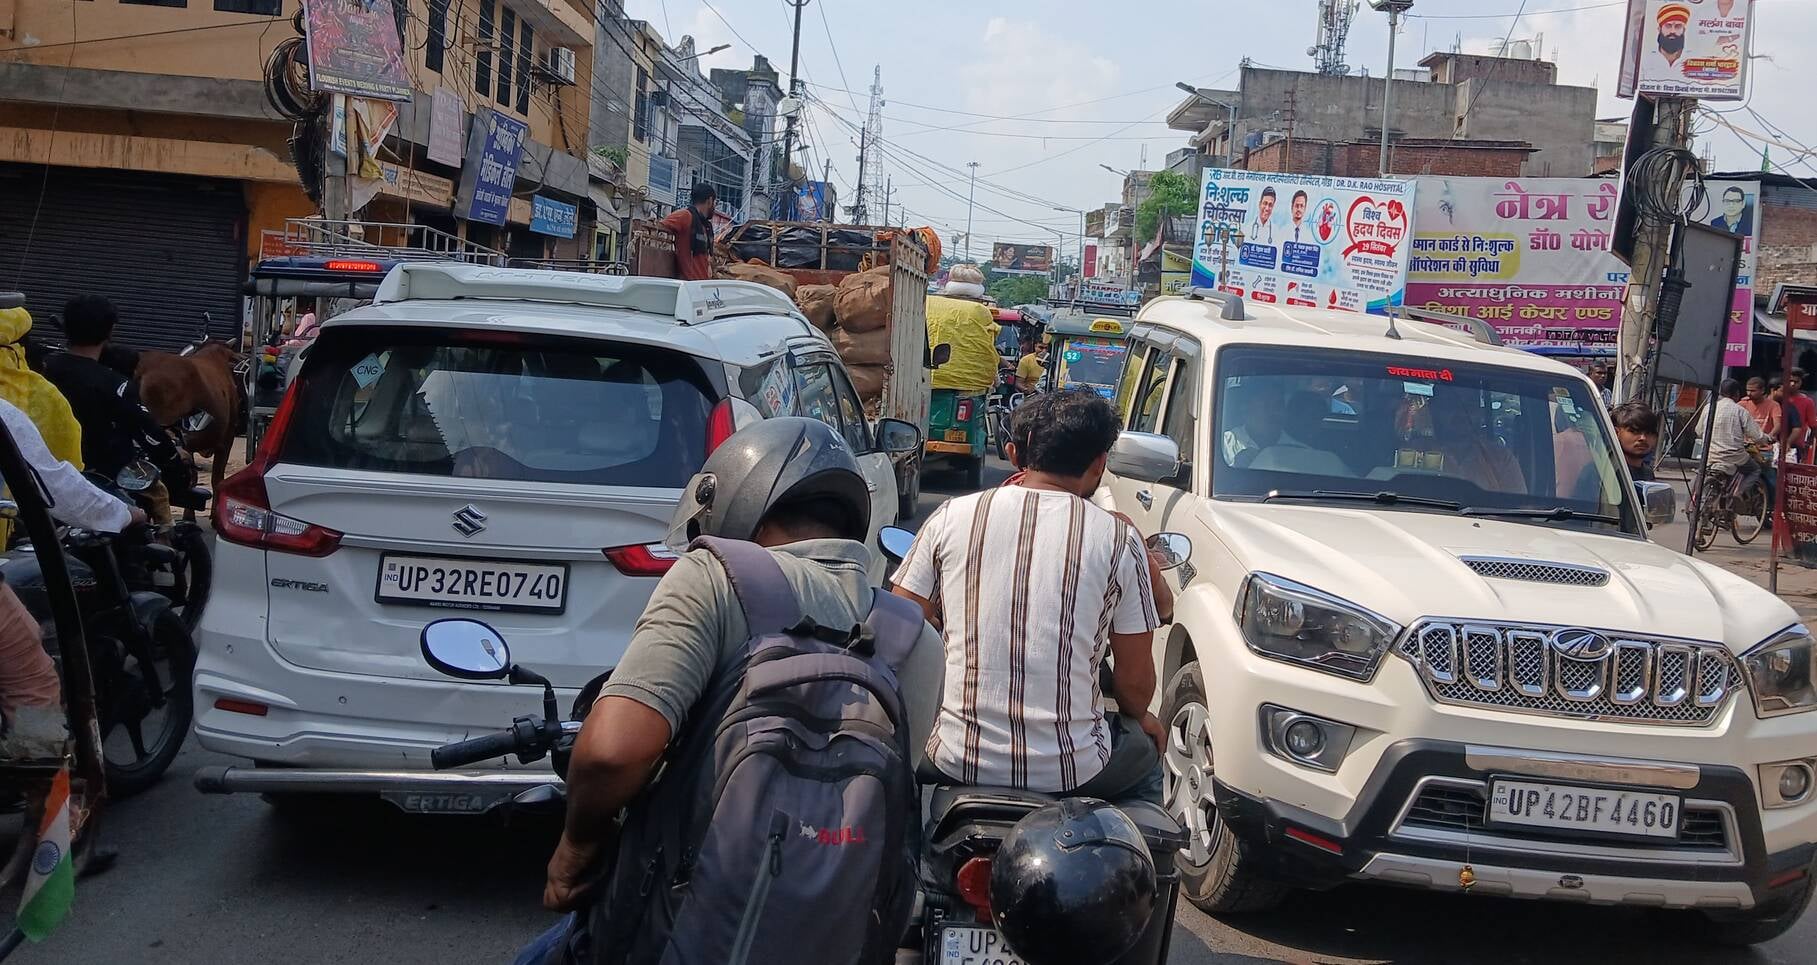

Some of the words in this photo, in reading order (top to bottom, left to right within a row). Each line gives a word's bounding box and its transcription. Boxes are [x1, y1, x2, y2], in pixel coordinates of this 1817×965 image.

[1336, 179, 1345, 187] DR.
[1347, 181, 1359, 189] D.K.
[1360, 182, 1373, 190] RAO
[1374, 183, 1404, 193] HOSPITAL
[1494, 181, 1576, 220] नेत्र
[1583, 182, 1618, 220] रो
[1203, 201, 1247, 224] चिकित्सा
[1363, 207, 1381, 221] विश्व
[1353, 222, 1374, 238] हृदय
[1376, 221, 1402, 240] दिवस
[1412, 239, 1436, 252] ष्मान
[1438, 236, 1459, 251] कार्ड
[1462, 236, 1469, 252] से
[1569, 228, 1609, 251] योगे
[1453, 257, 1466, 272] की
[1469, 258, 1500, 277] सुविधा
[1607, 272, 1631, 283] पर
[1438, 286, 1548, 302] अत्याधुनिक
[1477, 303, 1514, 320] आई
[1520, 304, 1568, 320] केयर
[1575, 307, 1614, 321] एण्ड
[1801, 303, 1817, 316] या
[1496, 323, 1542, 335] जानकी
[1066, 352, 1077, 360] 52
[357, 365, 379, 375] CNG
[270, 577, 329, 593] ERTIGA
[384, 573, 399, 582] IND
[398, 565, 560, 600] UP32RE0740
[404, 795, 482, 810] ERTIGA
[1493, 797, 1508, 806] IND
[1508, 789, 1674, 829] UP42BF4460
[946, 950, 960, 958] IND
